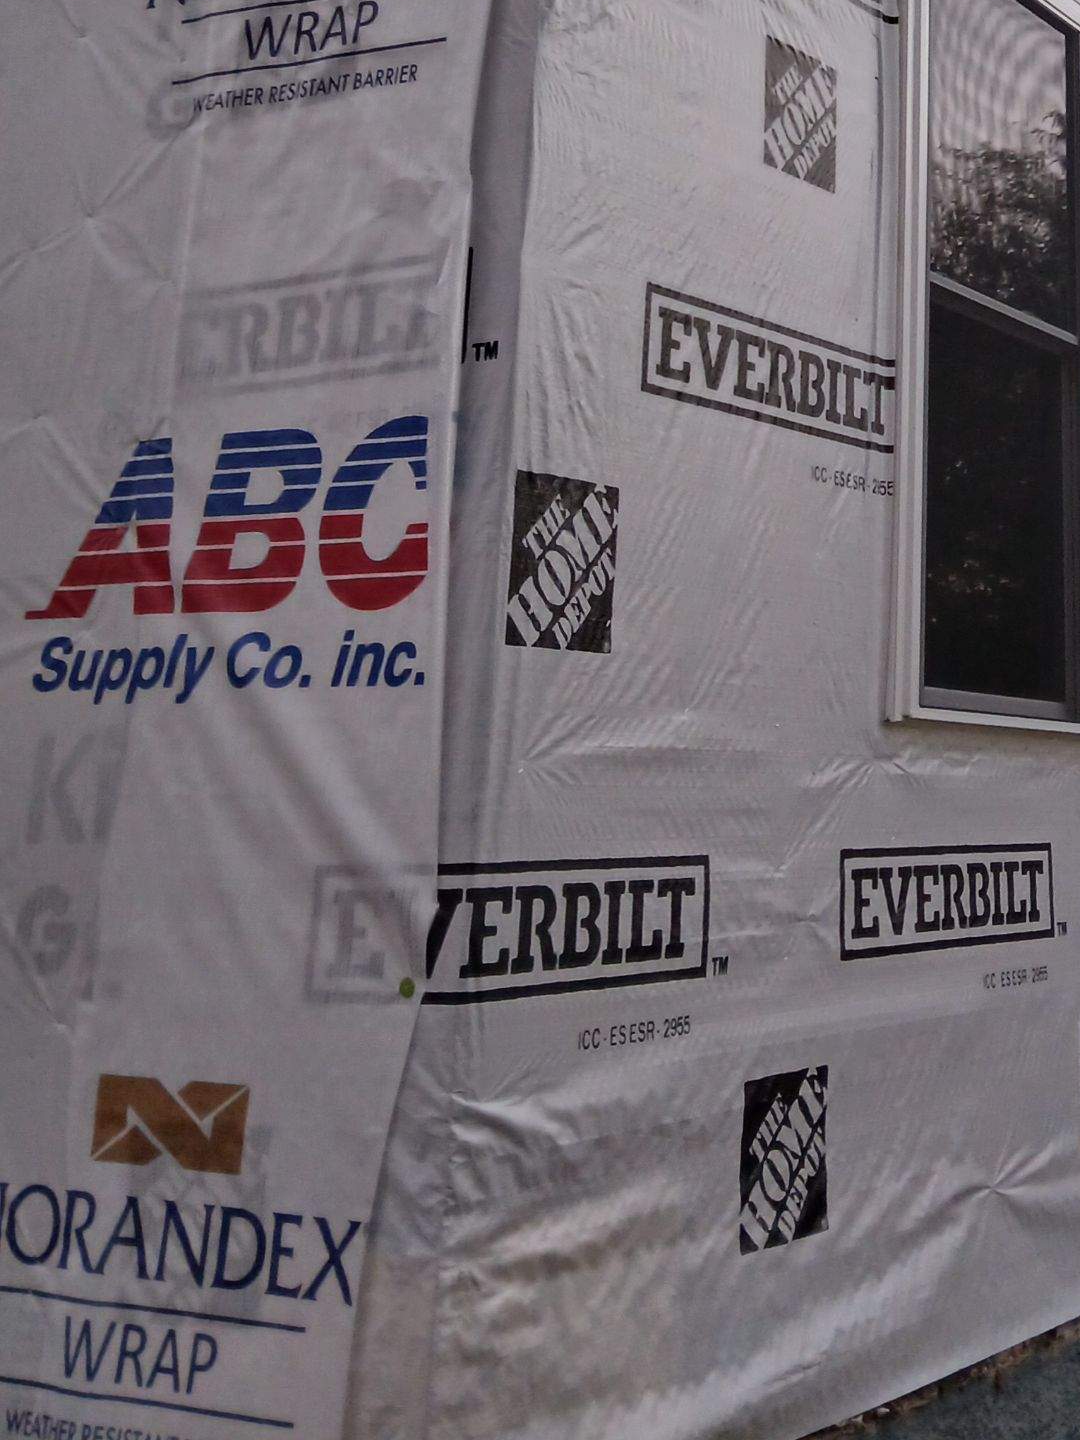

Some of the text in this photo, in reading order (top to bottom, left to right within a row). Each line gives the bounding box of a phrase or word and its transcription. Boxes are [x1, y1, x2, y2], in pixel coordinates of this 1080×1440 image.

[244, 0, 380, 61] WRAP
[192, 64, 419, 112] WEATHER RESISTANT BARRIER
[764, 63, 837, 171] HOME
[472, 341, 499, 361] TM
[655, 305, 896, 437] EVERBILT
[25, 415, 429, 620] ABC
[521, 493, 571, 561] THE
[507, 482, 619, 648] HOME
[551, 546, 616, 651] DEPOT
[32, 628, 426, 704] Supply Co. inc.
[850, 860, 1044, 940] EVERBILT
[711, 955, 729, 977] TM
[739, 1065, 828, 1251] HOME
[778, 1126, 827, 1242] DEPOT
[63, 1315, 219, 1395] WRAP
[5, 1409, 76, 1440] WEATHER
